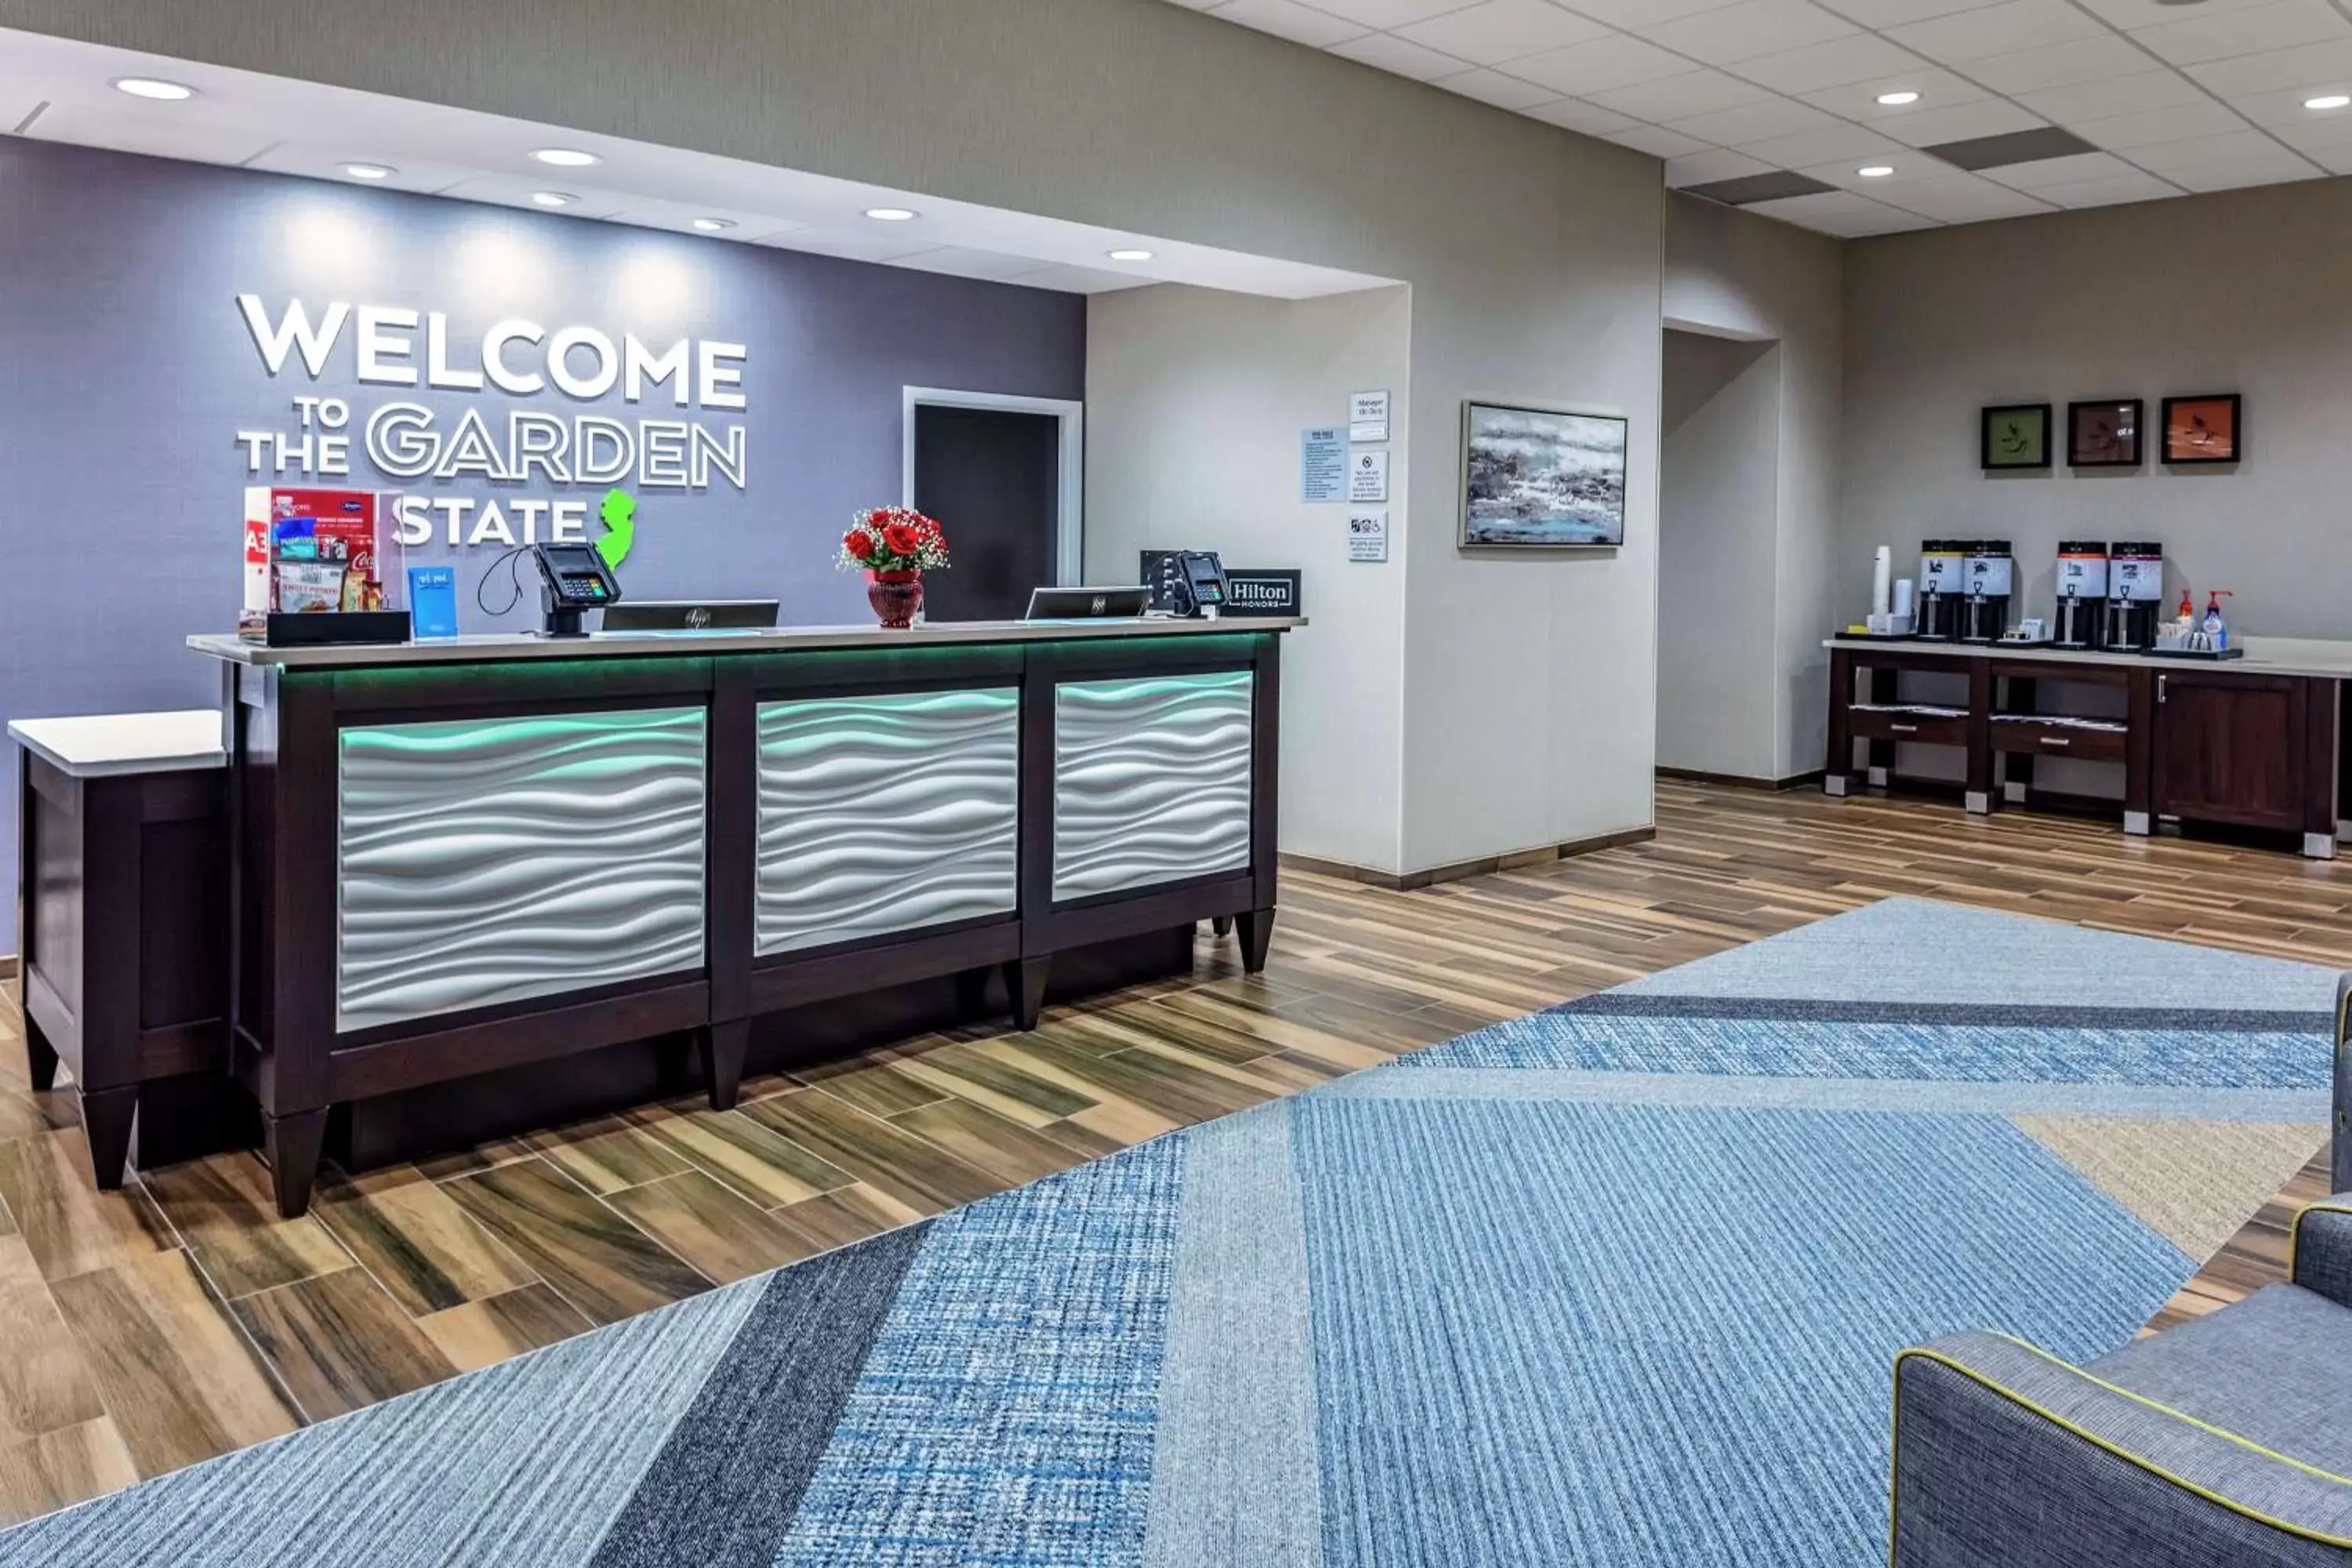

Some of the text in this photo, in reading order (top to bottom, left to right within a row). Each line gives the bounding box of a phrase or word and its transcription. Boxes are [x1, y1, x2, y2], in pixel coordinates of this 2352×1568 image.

[237, 294, 746, 412] WELCOME
[293, 396, 349, 428] TO
[237, 430, 350, 477] THE
[365, 401, 746, 490] GARDEN
[391, 495, 587, 546] STATE
[1234, 583, 1287, 599] Hilton
